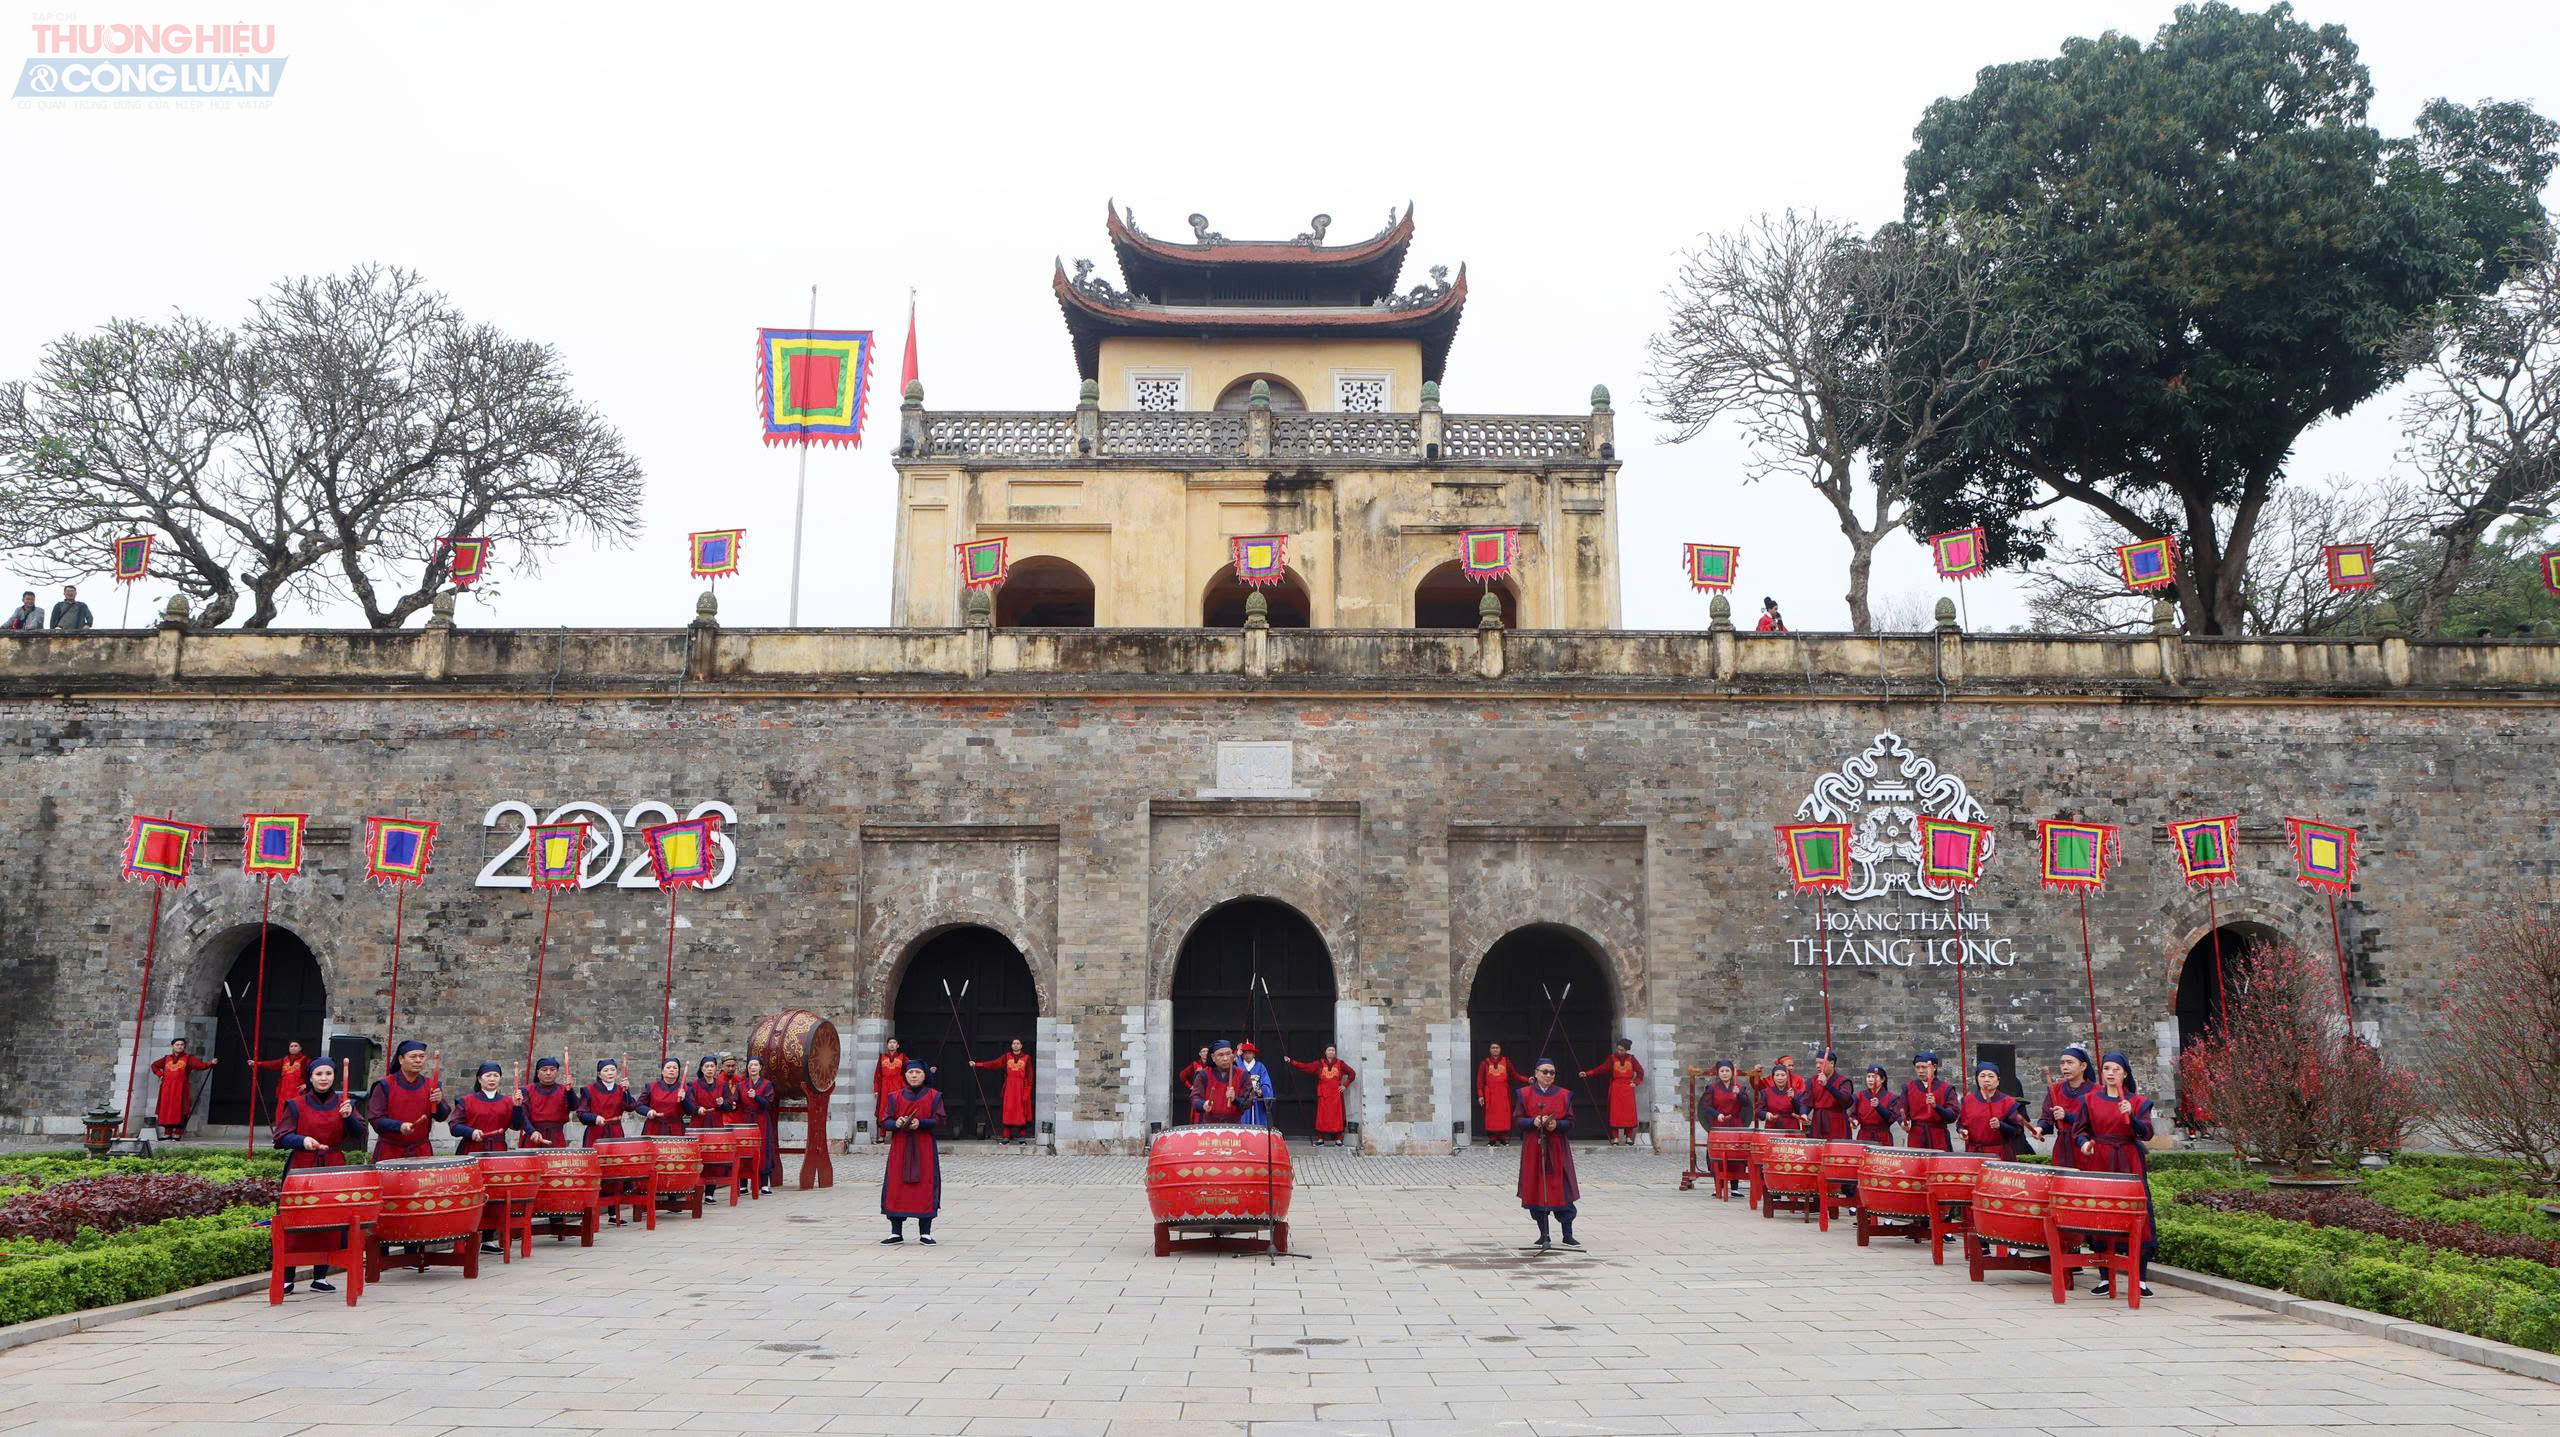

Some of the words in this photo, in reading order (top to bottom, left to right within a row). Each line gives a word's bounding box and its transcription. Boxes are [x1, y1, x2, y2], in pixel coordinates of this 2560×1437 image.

[1815, 908, 1901, 931] HOÀNG
[1906, 908, 1991, 931] THÀNH
[1786, 932, 1916, 967] THĂNG
[1927, 937, 2017, 967] LONG
